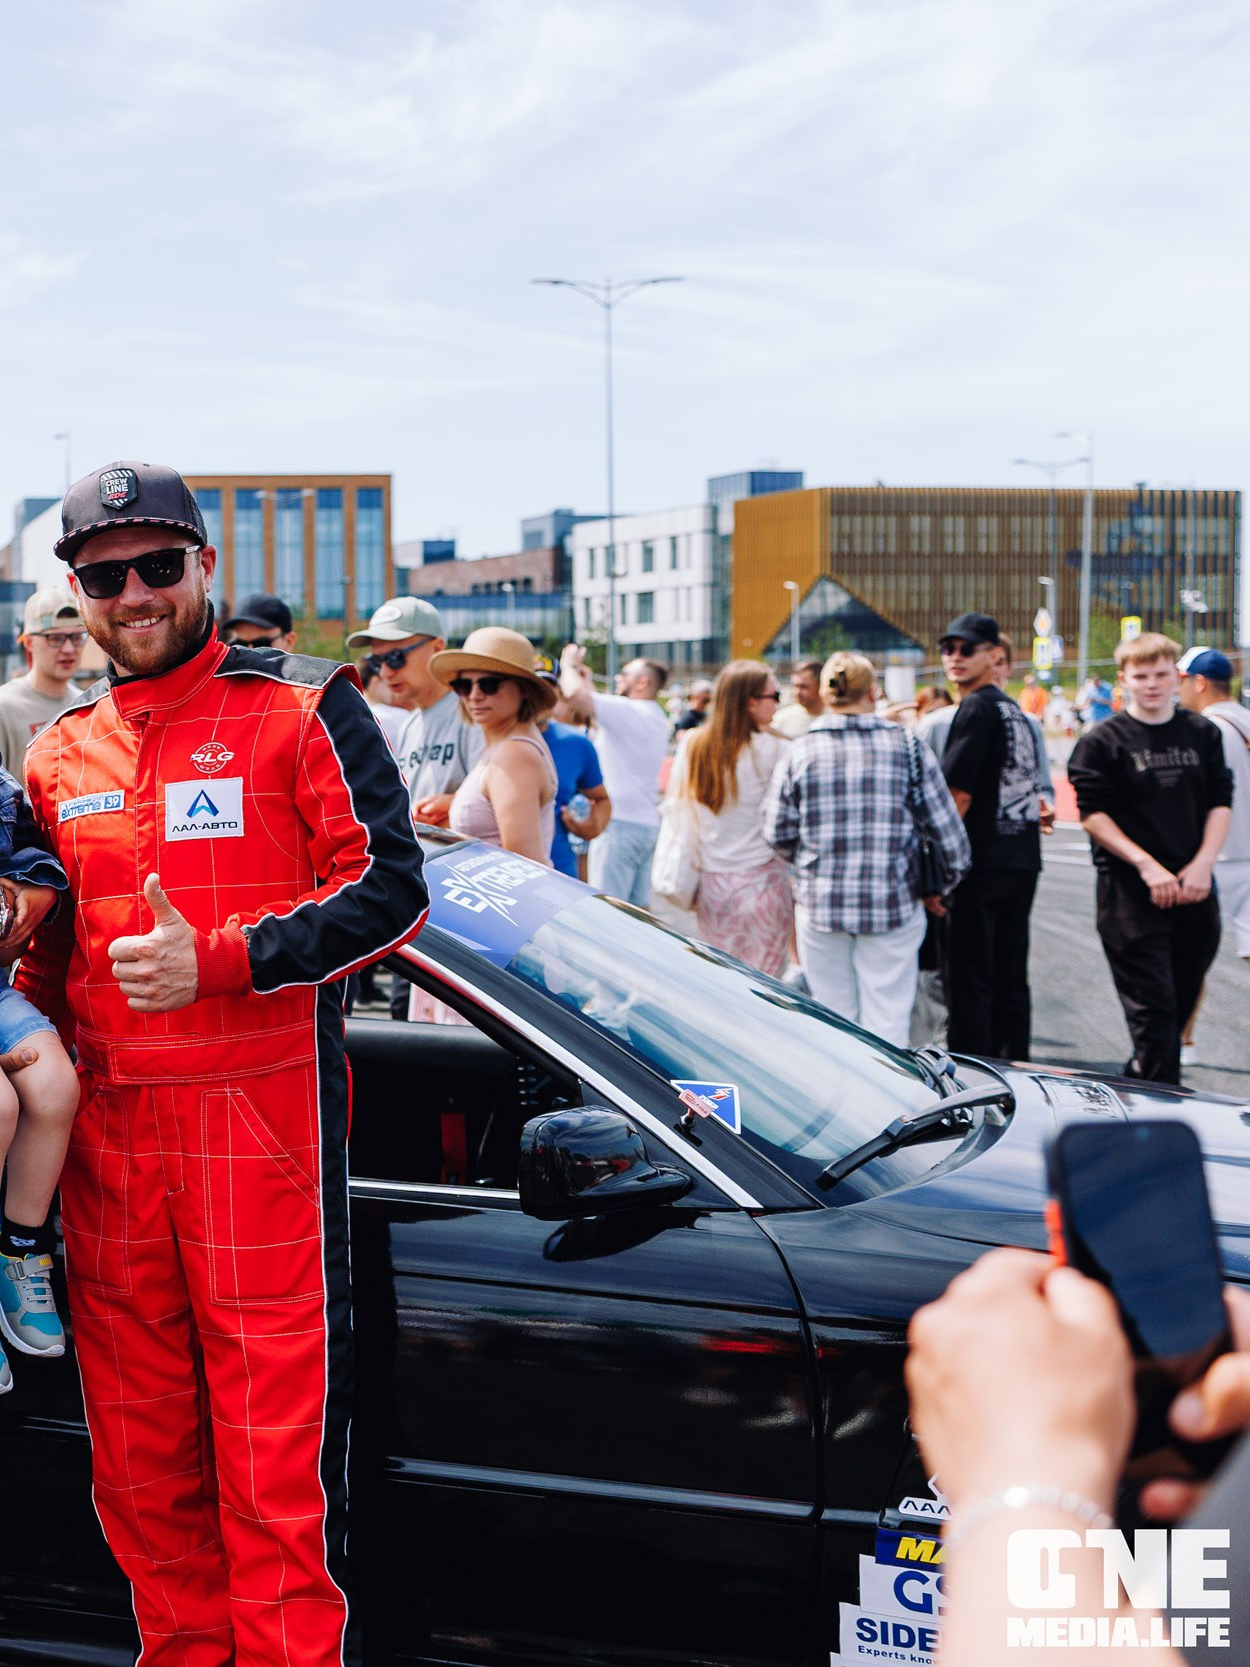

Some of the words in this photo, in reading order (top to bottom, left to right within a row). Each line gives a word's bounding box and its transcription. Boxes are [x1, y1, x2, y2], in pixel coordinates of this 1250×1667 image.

[106, 478, 128, 487] CREW
[106, 484, 129, 495] LINE
[191, 751, 235, 763] RLG
[106, 796, 120, 808] 39
[858, 1645, 906, 1662] Experts
